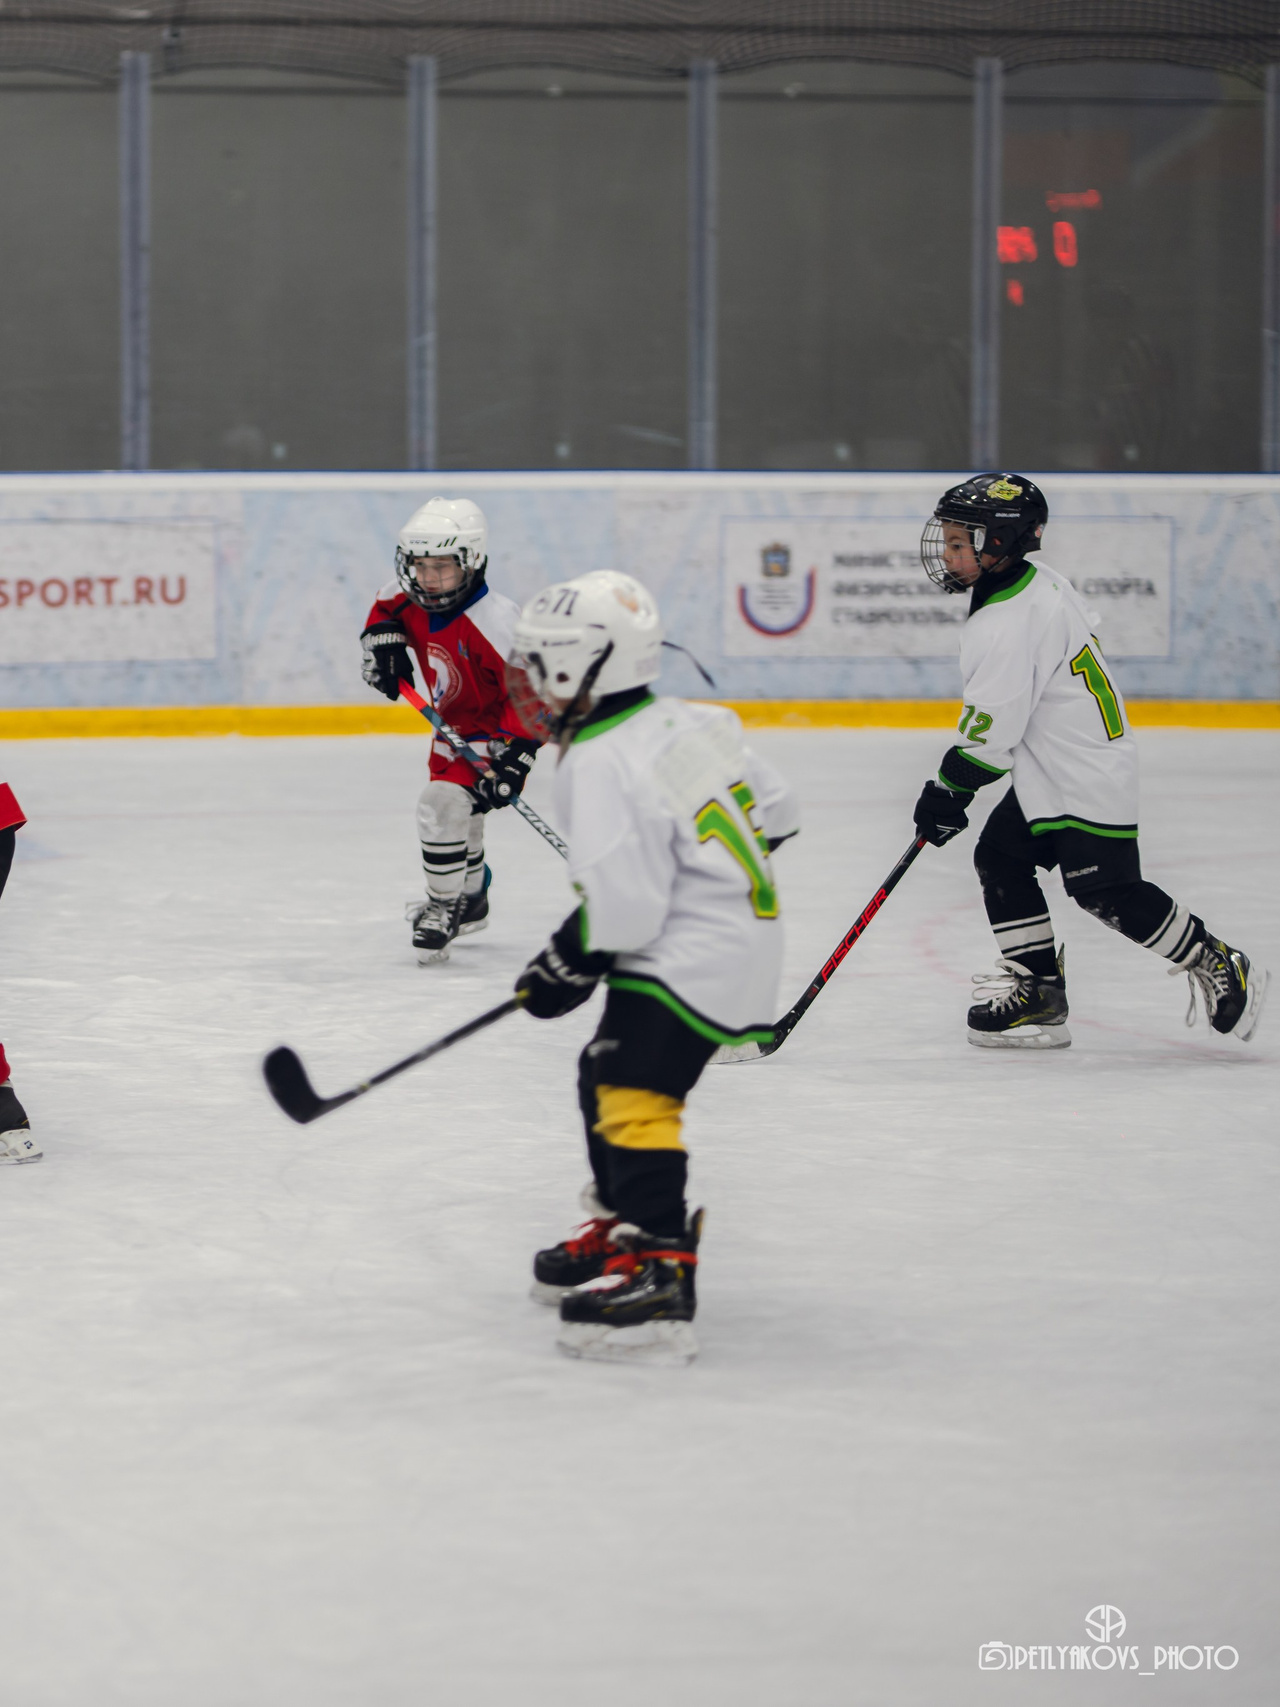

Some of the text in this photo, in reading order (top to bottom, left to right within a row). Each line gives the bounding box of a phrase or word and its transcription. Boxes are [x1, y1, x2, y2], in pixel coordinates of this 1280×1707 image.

[551, 587, 579, 617] 71
[1070, 633, 1124, 741] 1
[958, 705, 993, 744] 12
[821, 887, 887, 983] FISCHER
